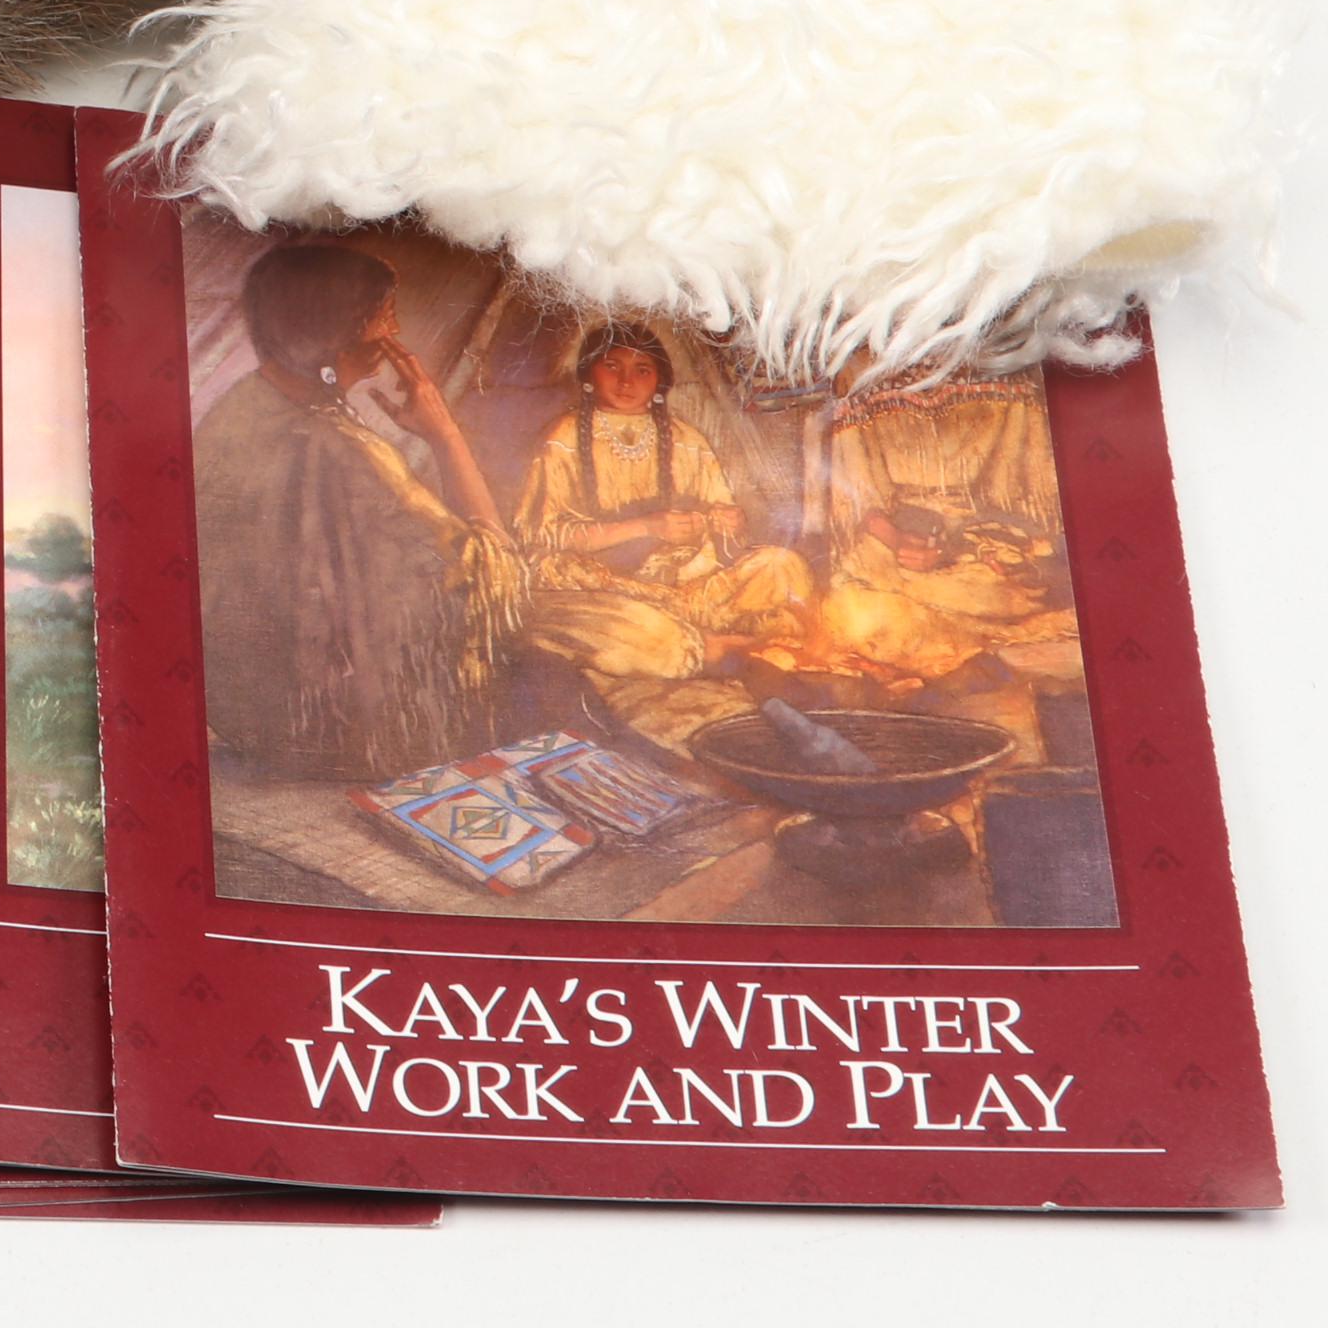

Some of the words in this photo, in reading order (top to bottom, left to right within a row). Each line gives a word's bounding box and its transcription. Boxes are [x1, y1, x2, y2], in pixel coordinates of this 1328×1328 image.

[318, 963, 633, 1048] KAYA'S
[654, 979, 1034, 1055] WINTER
[285, 1037, 585, 1124] WORK
[608, 1065, 815, 1128] AND
[839, 1059, 1075, 1133] PLAY
